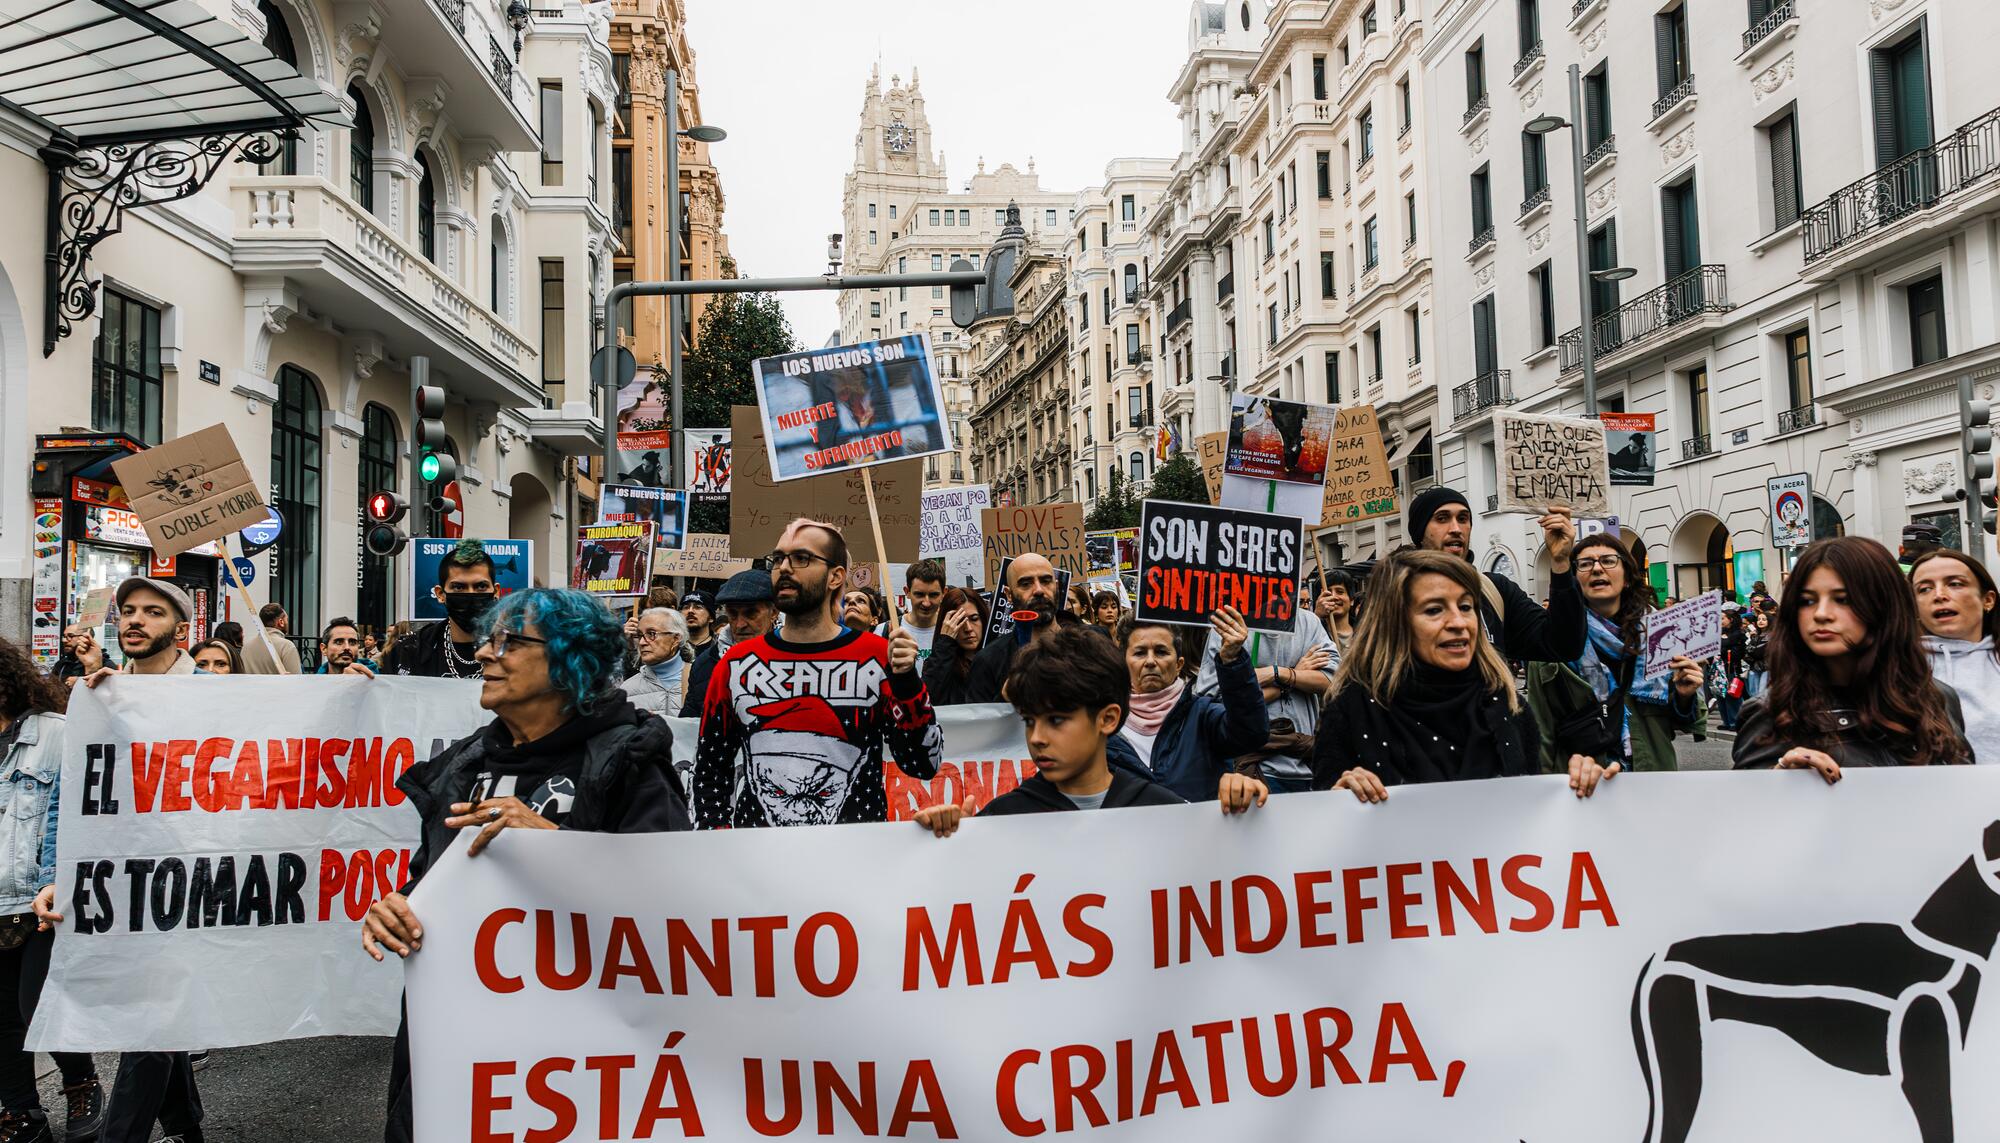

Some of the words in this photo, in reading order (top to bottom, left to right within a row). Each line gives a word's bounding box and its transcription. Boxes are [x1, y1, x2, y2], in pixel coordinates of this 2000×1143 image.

[782, 358, 811, 377] LOS
[812, 349, 872, 373] HUEVOS
[874, 343, 905, 363] SON
[777, 401, 837, 431] MUERTE
[1352, 414, 1369, 427] NO
[809, 428, 819, 443] Y
[1504, 420, 1557, 441] HASTA
[1563, 426, 1593, 442] QUE
[804, 430, 903, 470] SUFRIMIENTO
[1336, 436, 1364, 452] PARA
[1512, 440, 1589, 457] ANIMAL
[1244, 467, 1275, 475] VEGANISMO
[1335, 455, 1370, 471] IGUAL
[1511, 456, 1570, 472] LLEGA
[1572, 457, 1591, 471] TU
[78, 482, 90, 490] Bus
[1340, 475, 1354, 487] NO
[1356, 471, 1370, 483] ES
[1784, 480, 1805, 488] ACERA
[77, 490, 91, 499] Tour
[615, 488, 629, 497] LOS
[630, 489, 659, 499] HUEVOS
[660, 492, 676, 501] SON
[967, 490, 987, 505] PQ
[160, 506, 217, 540] DOBLE
[217, 491, 265, 519] MORAL
[1347, 505, 1359, 518] GO
[1363, 498, 1394, 515] VEGAN
[605, 513, 635, 521] MUERTE
[940, 510, 950, 523] A
[997, 506, 1065, 533] LOVE
[586, 525, 643, 539] TAUROMAQUIA
[943, 523, 961, 535] NO
[967, 523, 978, 534] A
[986, 526, 1080, 557] ANIMALS?
[1149, 515, 1209, 565] SON
[1217, 521, 1295, 574] SERES
[423, 544, 444, 555] SUS
[485, 545, 520, 556] NADAN,
[680, 551, 695, 560] ES
[690, 562, 723, 572] ALGO
[587, 577, 630, 591] ABOLICIÓN
[1144, 565, 1295, 621] SINTIENTES
[729, 653, 888, 706] KREATOR
[82, 743, 118, 815] EL
[131, 737, 415, 813] VEGANISMO
[73, 858, 114, 935] ES
[124, 852, 305, 931] TOMAR
[318, 848, 413, 921] POSI
[473, 908, 860, 998] CUANTO
[902, 873, 1115, 992] MÁS
[1150, 851, 1620, 970] INDEFENSA
[471, 1031, 705, 1143] ESTÁ
[743, 1058, 960, 1140] UNA
[995, 1002, 1467, 1138] CRIATURA,
